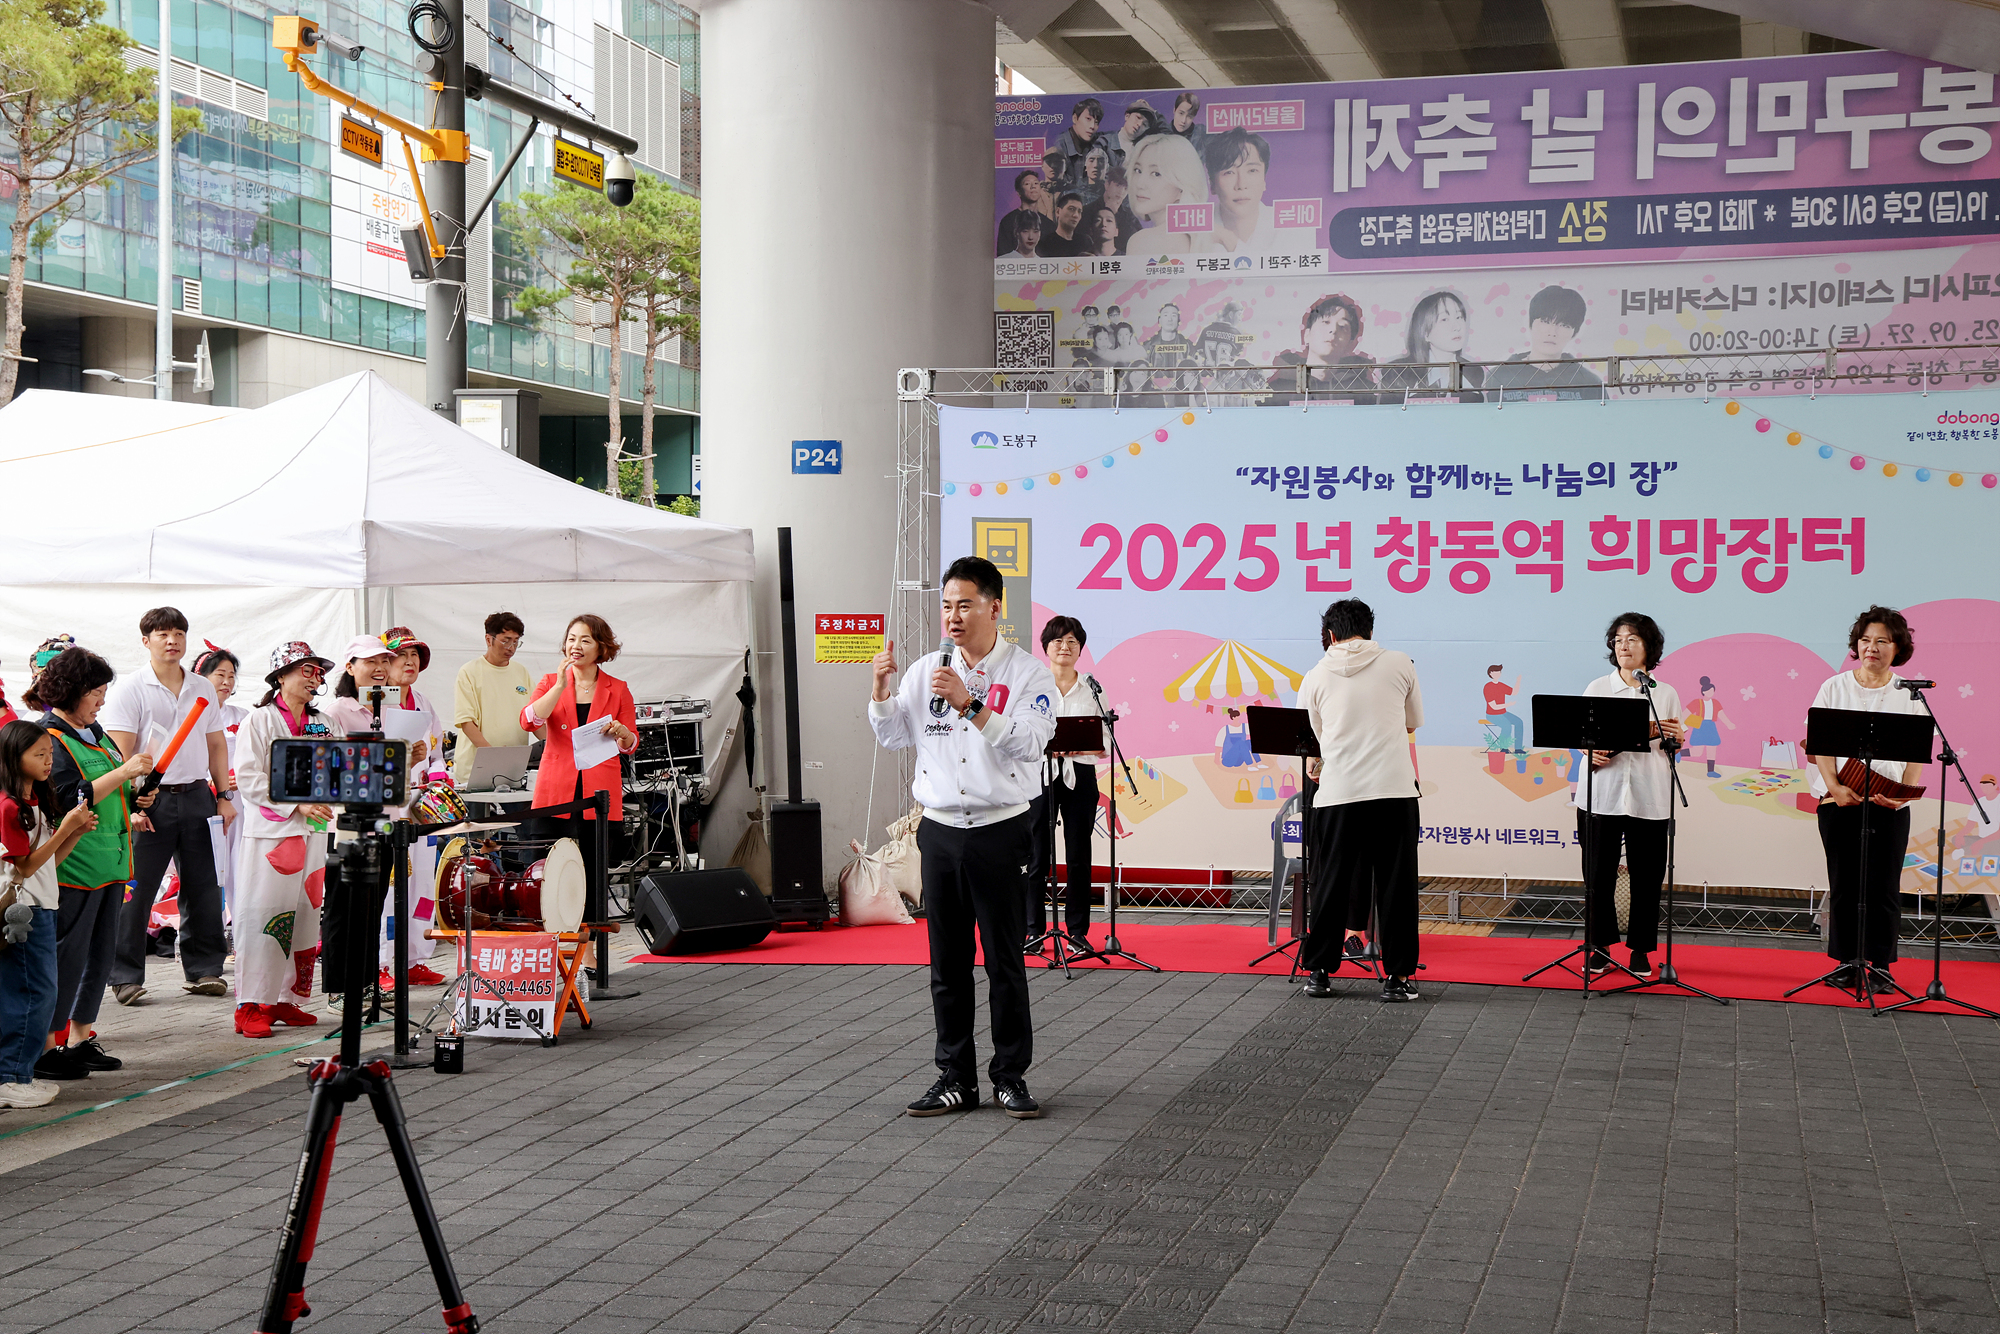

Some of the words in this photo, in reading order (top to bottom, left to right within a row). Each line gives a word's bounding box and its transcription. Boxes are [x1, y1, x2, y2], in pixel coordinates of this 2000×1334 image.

[342, 127, 359, 147] CCTV
[372, 193, 410, 222] 주방연기
[1936, 410, 2000, 426] dobong
[1002, 434, 1038, 448] 도봉구
[1906, 431, 1924, 442] 같이
[1950, 428, 1980, 441] 행복한
[795, 448, 839, 467] P24
[1405, 462, 1514, 499] 함께하는
[1522, 461, 1616, 498] 나눔의
[1373, 515, 1564, 595] 창동역
[1586, 514, 1866, 595] 희망장터
[819, 618, 880, 631] 주정차금지
[1495, 827, 1566, 849] 네트워크,
[510, 947, 554, 974] 창극단
